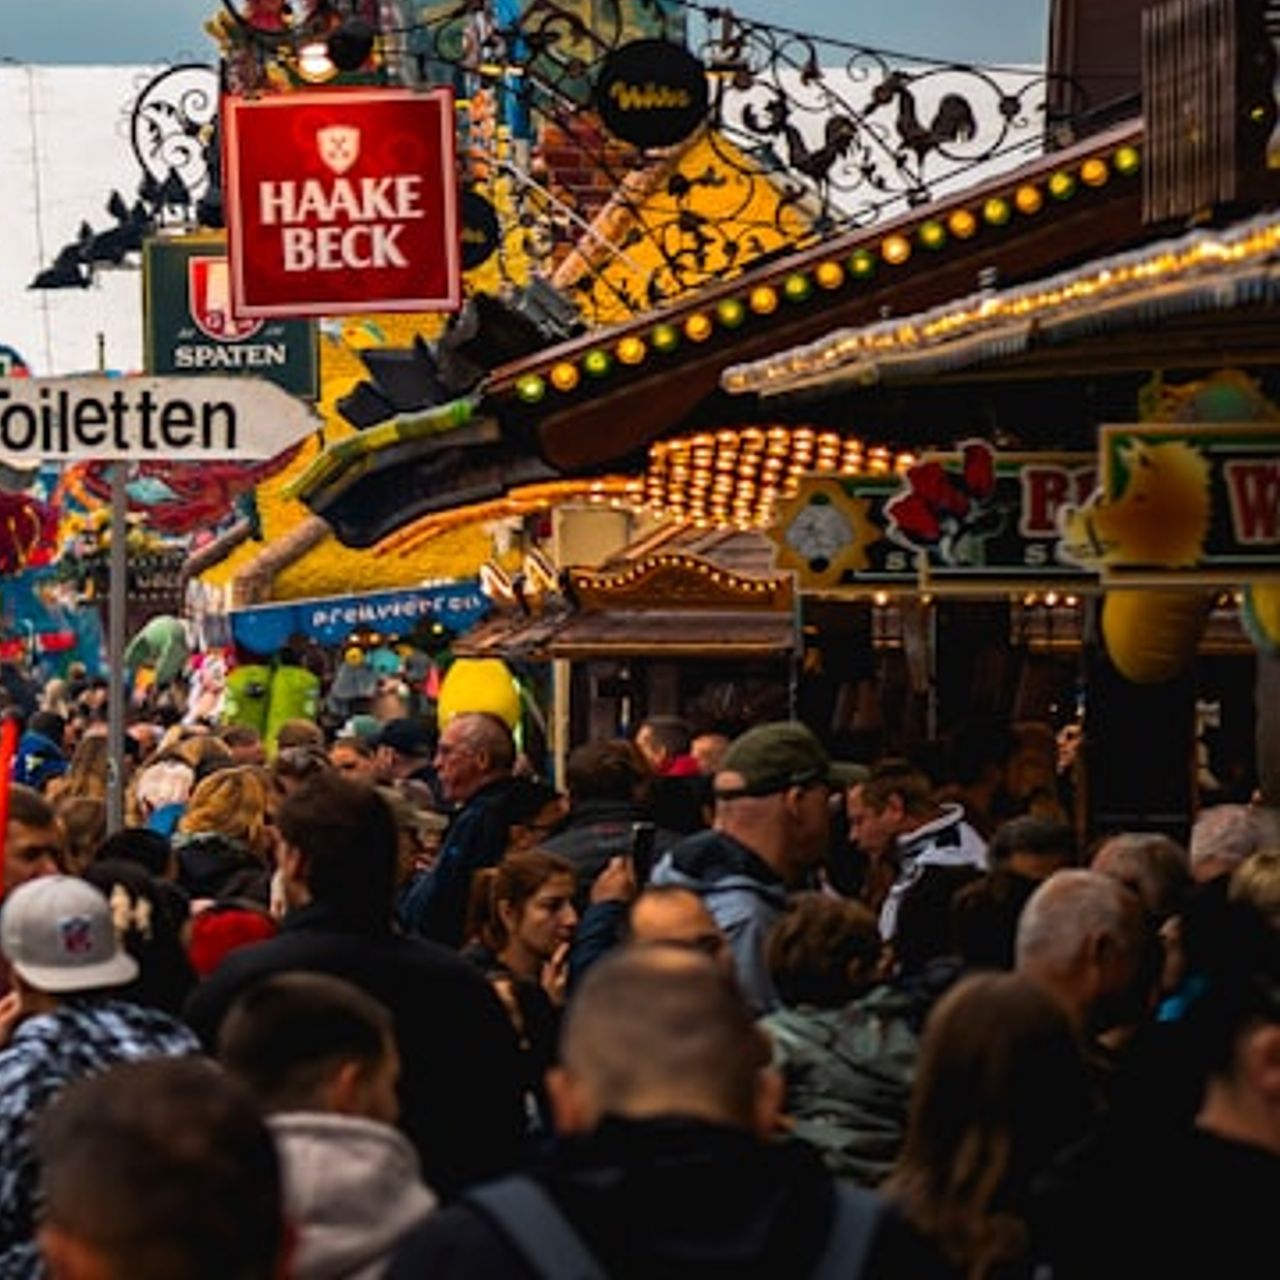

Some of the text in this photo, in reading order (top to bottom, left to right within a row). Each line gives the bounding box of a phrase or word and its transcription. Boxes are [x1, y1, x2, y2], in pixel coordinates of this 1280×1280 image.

[258, 174, 426, 226] HAAKE
[282, 223, 410, 272] BECK
[173, 343, 287, 368] SPATEN
